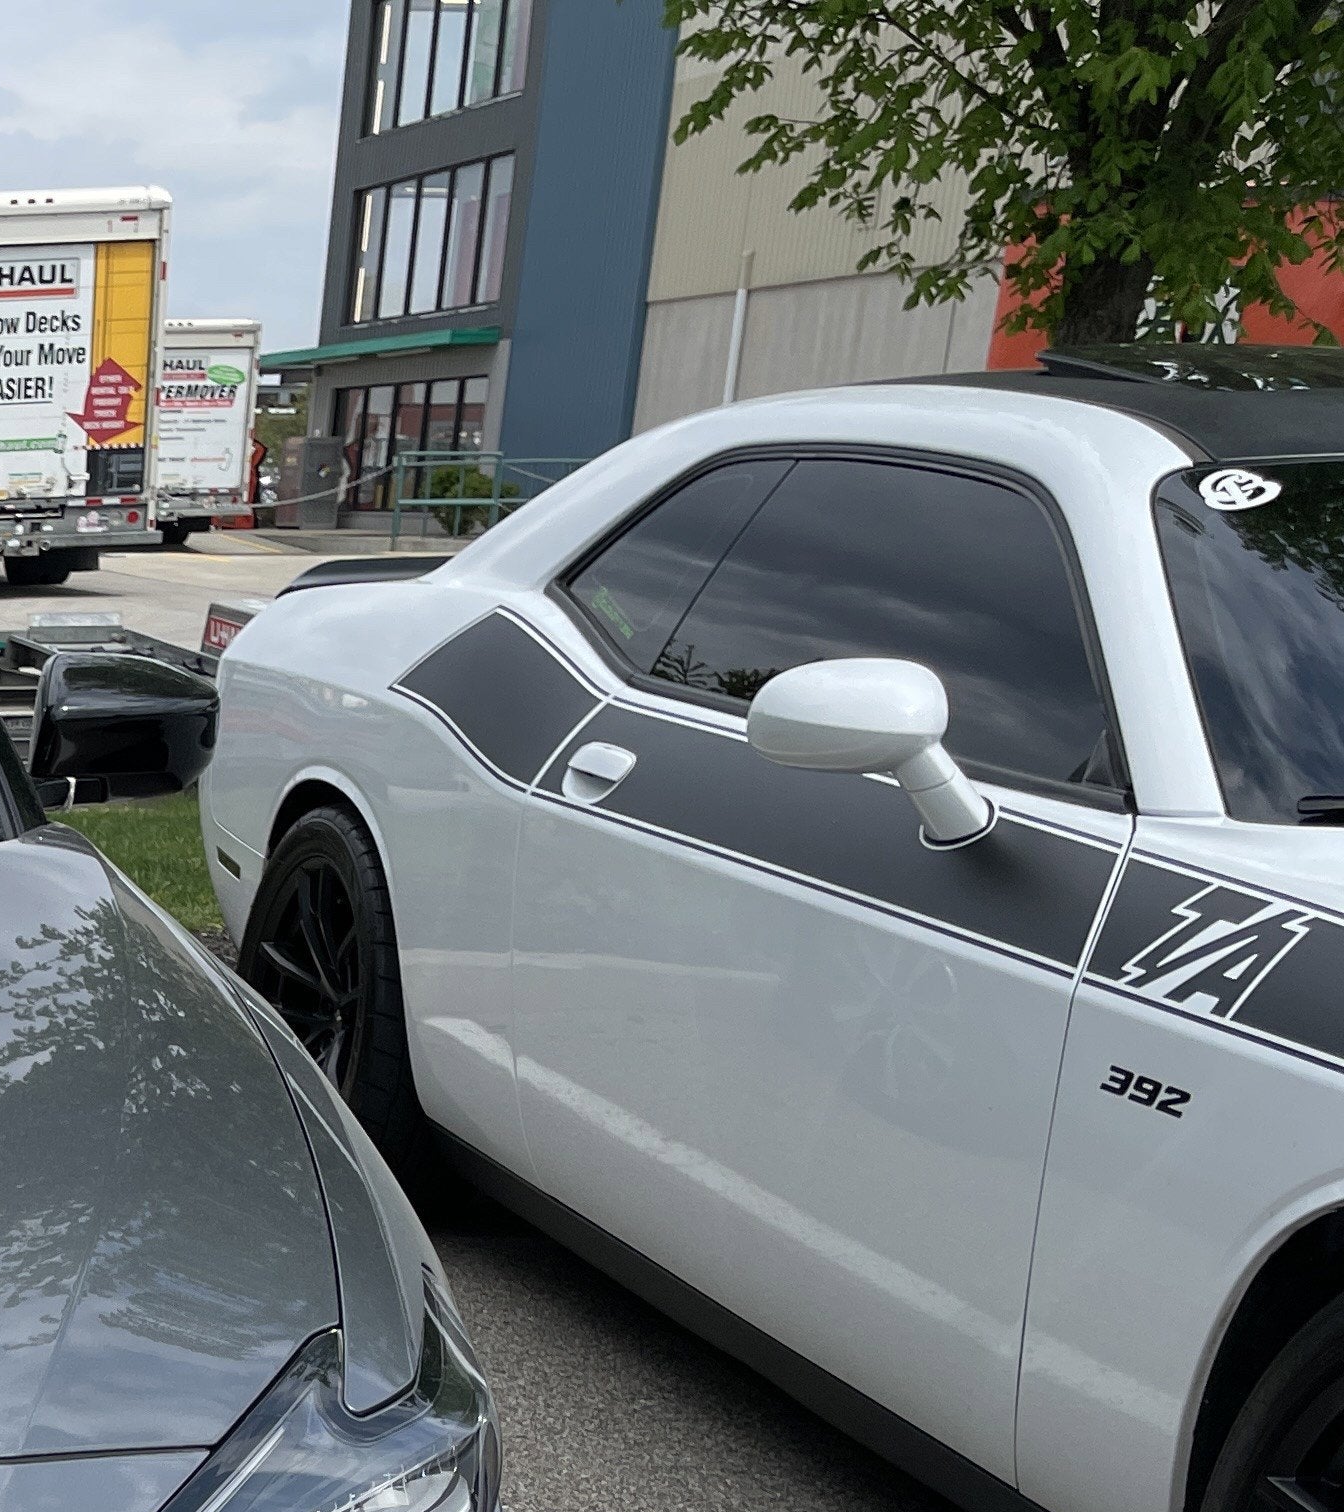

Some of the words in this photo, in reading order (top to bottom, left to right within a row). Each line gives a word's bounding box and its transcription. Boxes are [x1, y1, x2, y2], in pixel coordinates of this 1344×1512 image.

[25, 309, 82, 334] Decks
[38, 342, 87, 367] Move
[1099, 1065, 1192, 1119] 392
